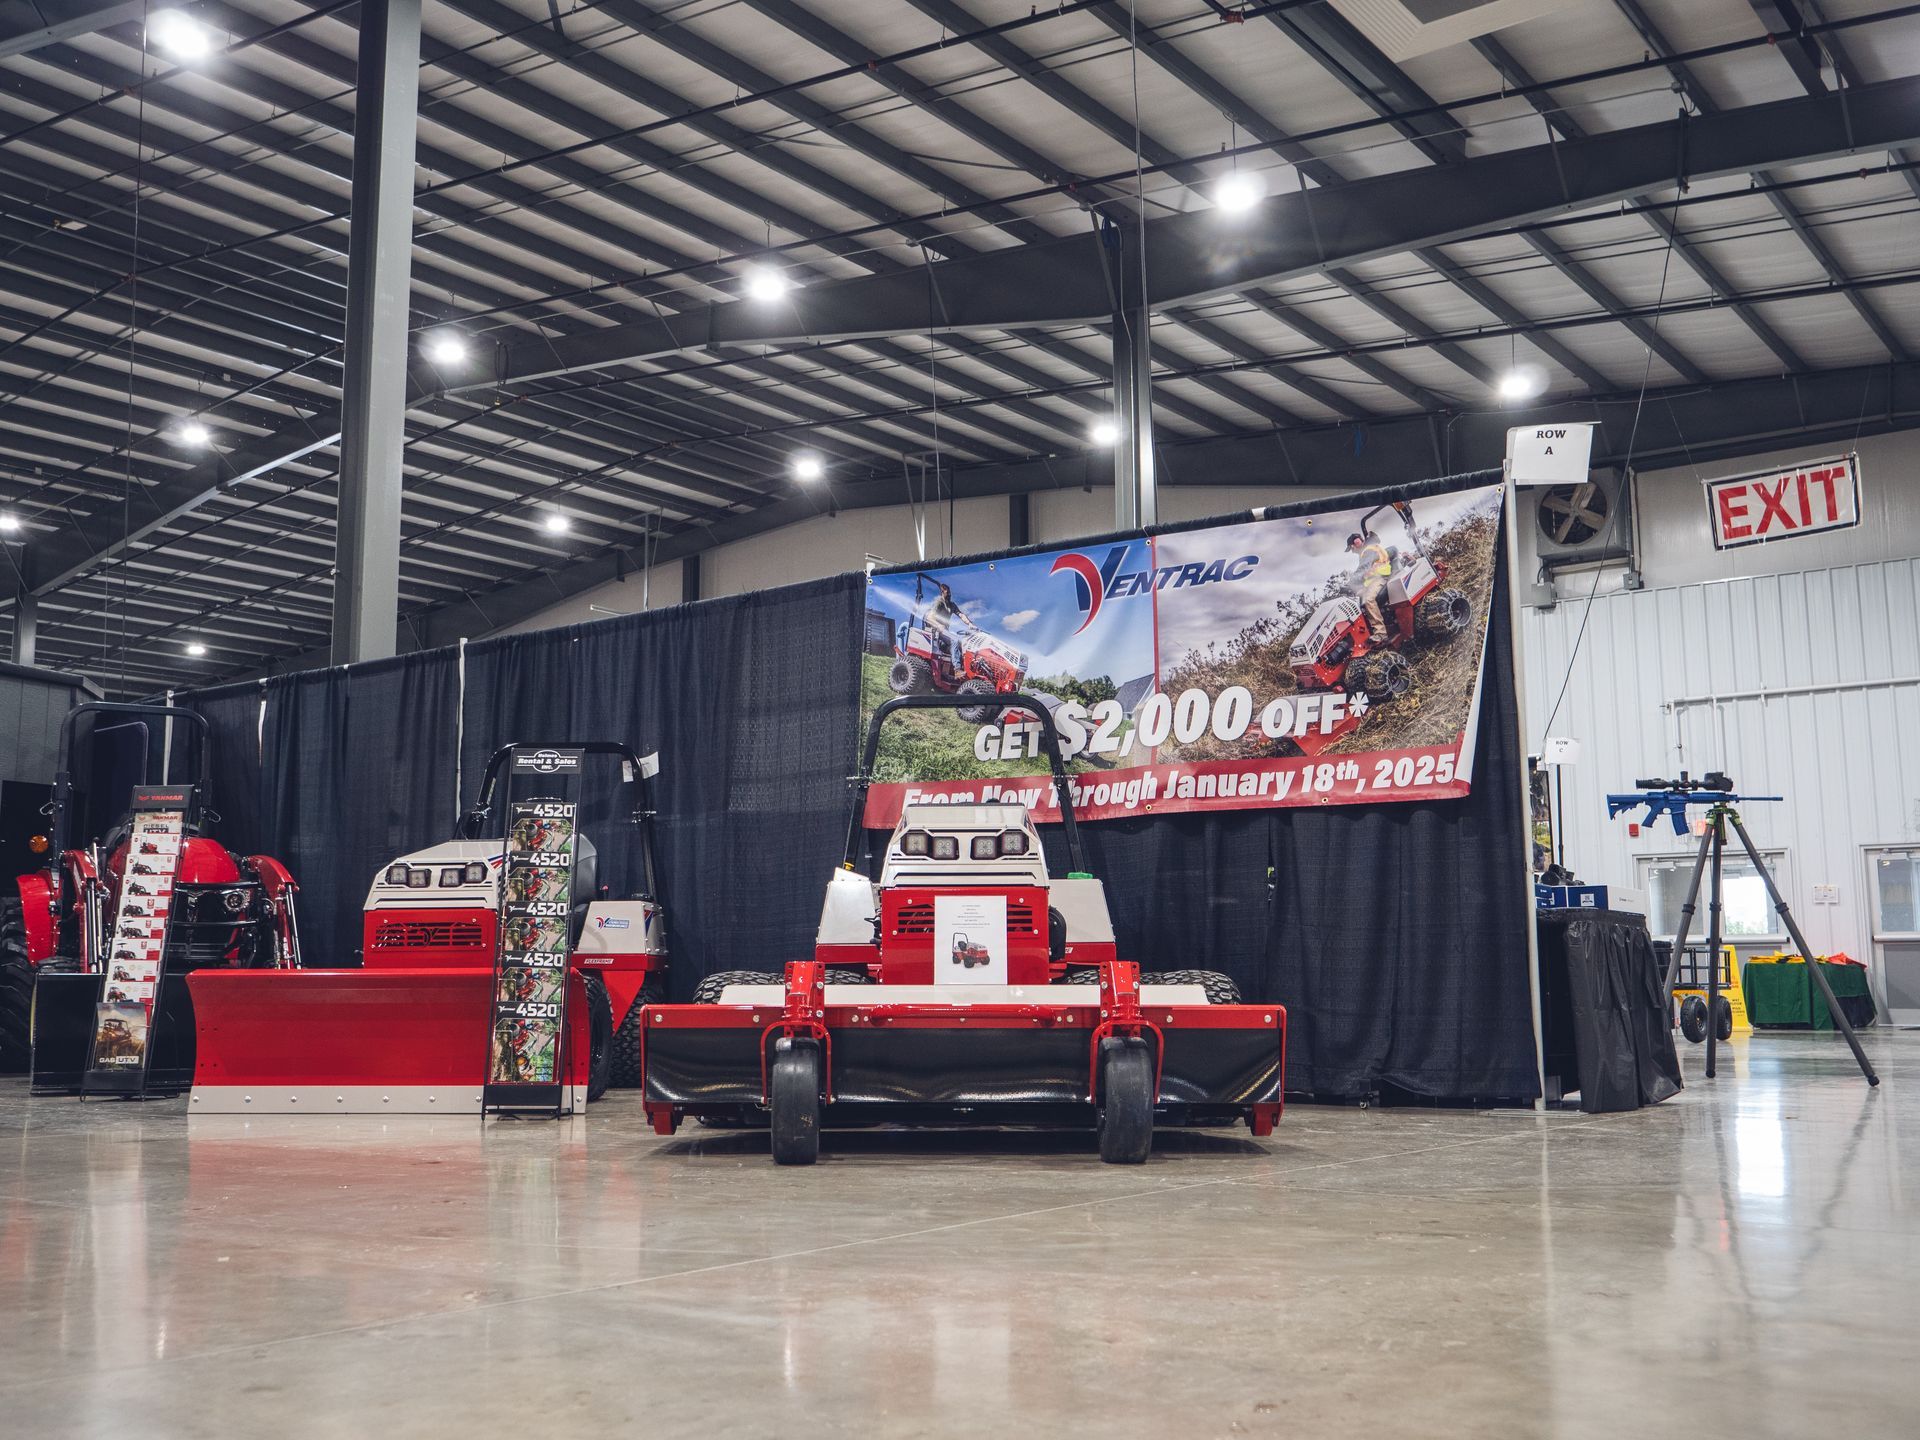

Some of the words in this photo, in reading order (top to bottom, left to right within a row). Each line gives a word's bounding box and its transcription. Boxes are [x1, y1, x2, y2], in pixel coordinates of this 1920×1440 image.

[1536, 430, 1566, 439] ROW
[1544, 446, 1554, 455] A
[1718, 466, 1846, 540] EXIT
[1050, 546, 1259, 635] VENTRAC
[974, 722, 1044, 762] GET
[1055, 686, 1253, 761] $2,000
[1048, 771, 1157, 810] Through
[1163, 771, 1296, 801] January
[1301, 760, 1366, 793] 18th,
[1372, 753, 1456, 789] 2025
[534, 804, 573, 817] 4520
[530, 853, 569, 866] 4520
[526, 903, 567, 915] 4520
[523, 953, 563, 967] 4520
[516, 1003, 557, 1017] 4520
